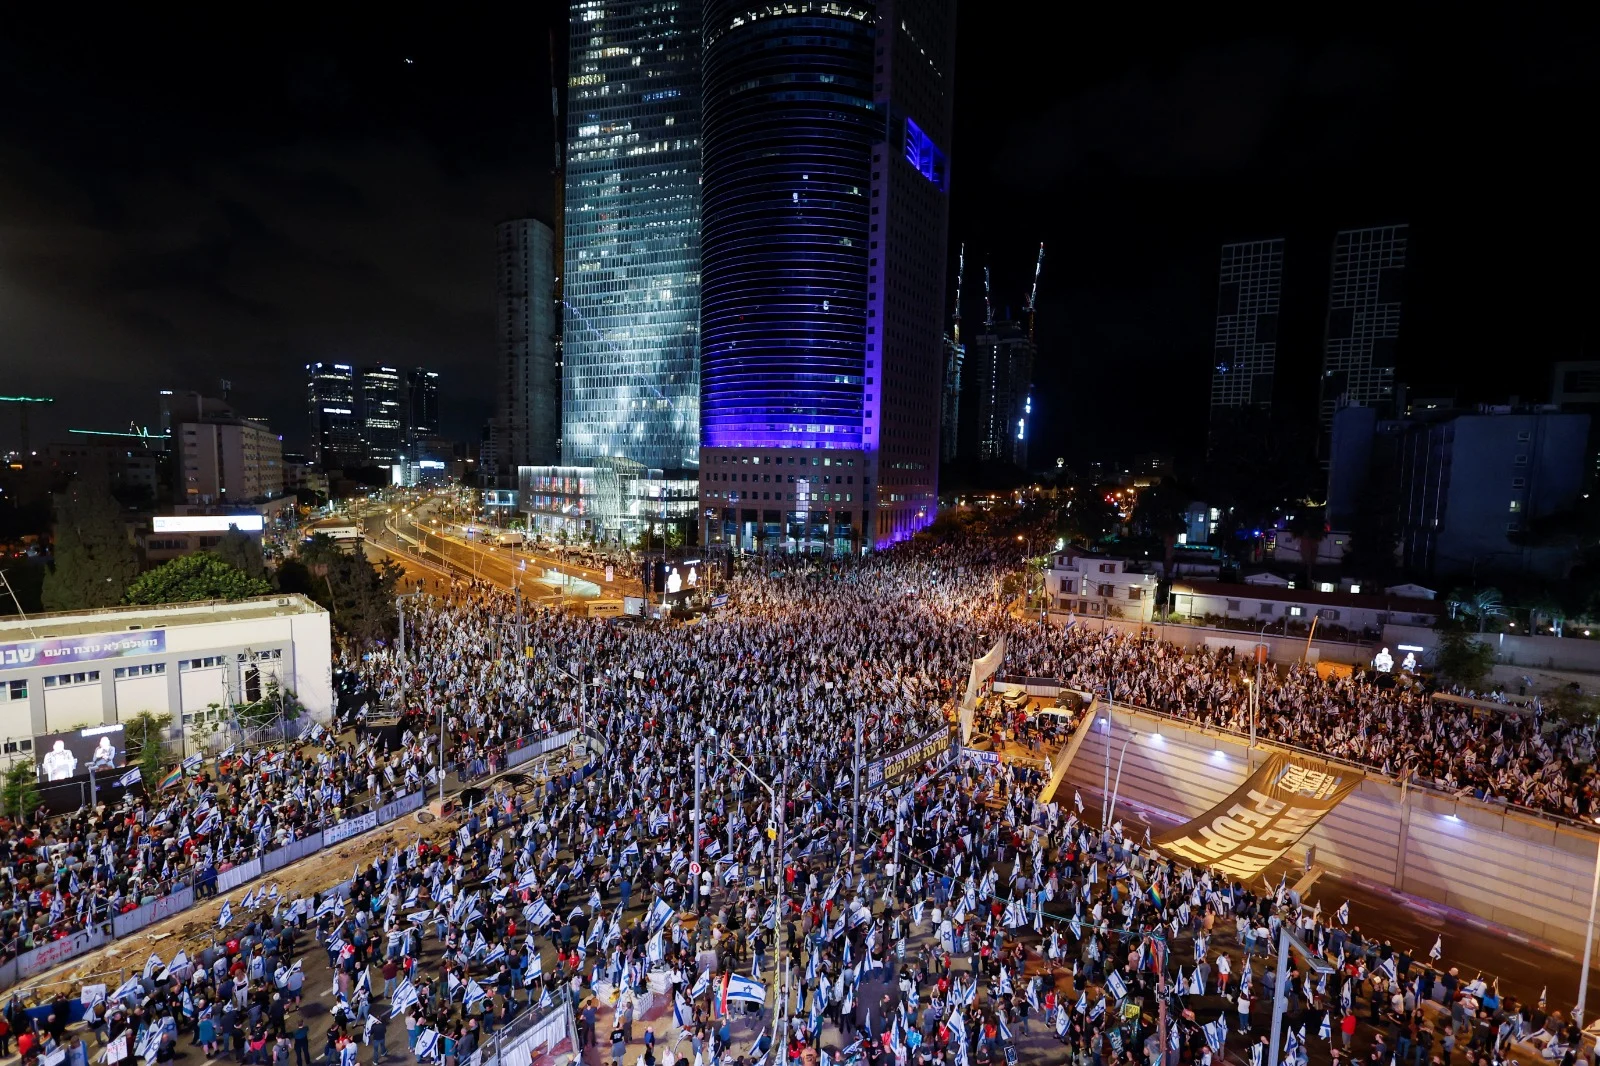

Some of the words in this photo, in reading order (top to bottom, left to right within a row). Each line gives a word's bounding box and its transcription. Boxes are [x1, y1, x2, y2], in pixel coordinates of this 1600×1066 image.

[74, 645, 100, 654] נוצח
[103, 641, 119, 651] לא
[122, 638, 158, 649] מעולם
[44, 647, 70, 657] העם
[906, 752, 921, 767] את
[884, 759, 905, 779] העם
[1158, 789, 1286, 863] PEOPLE
[1259, 807, 1330, 844] WE
